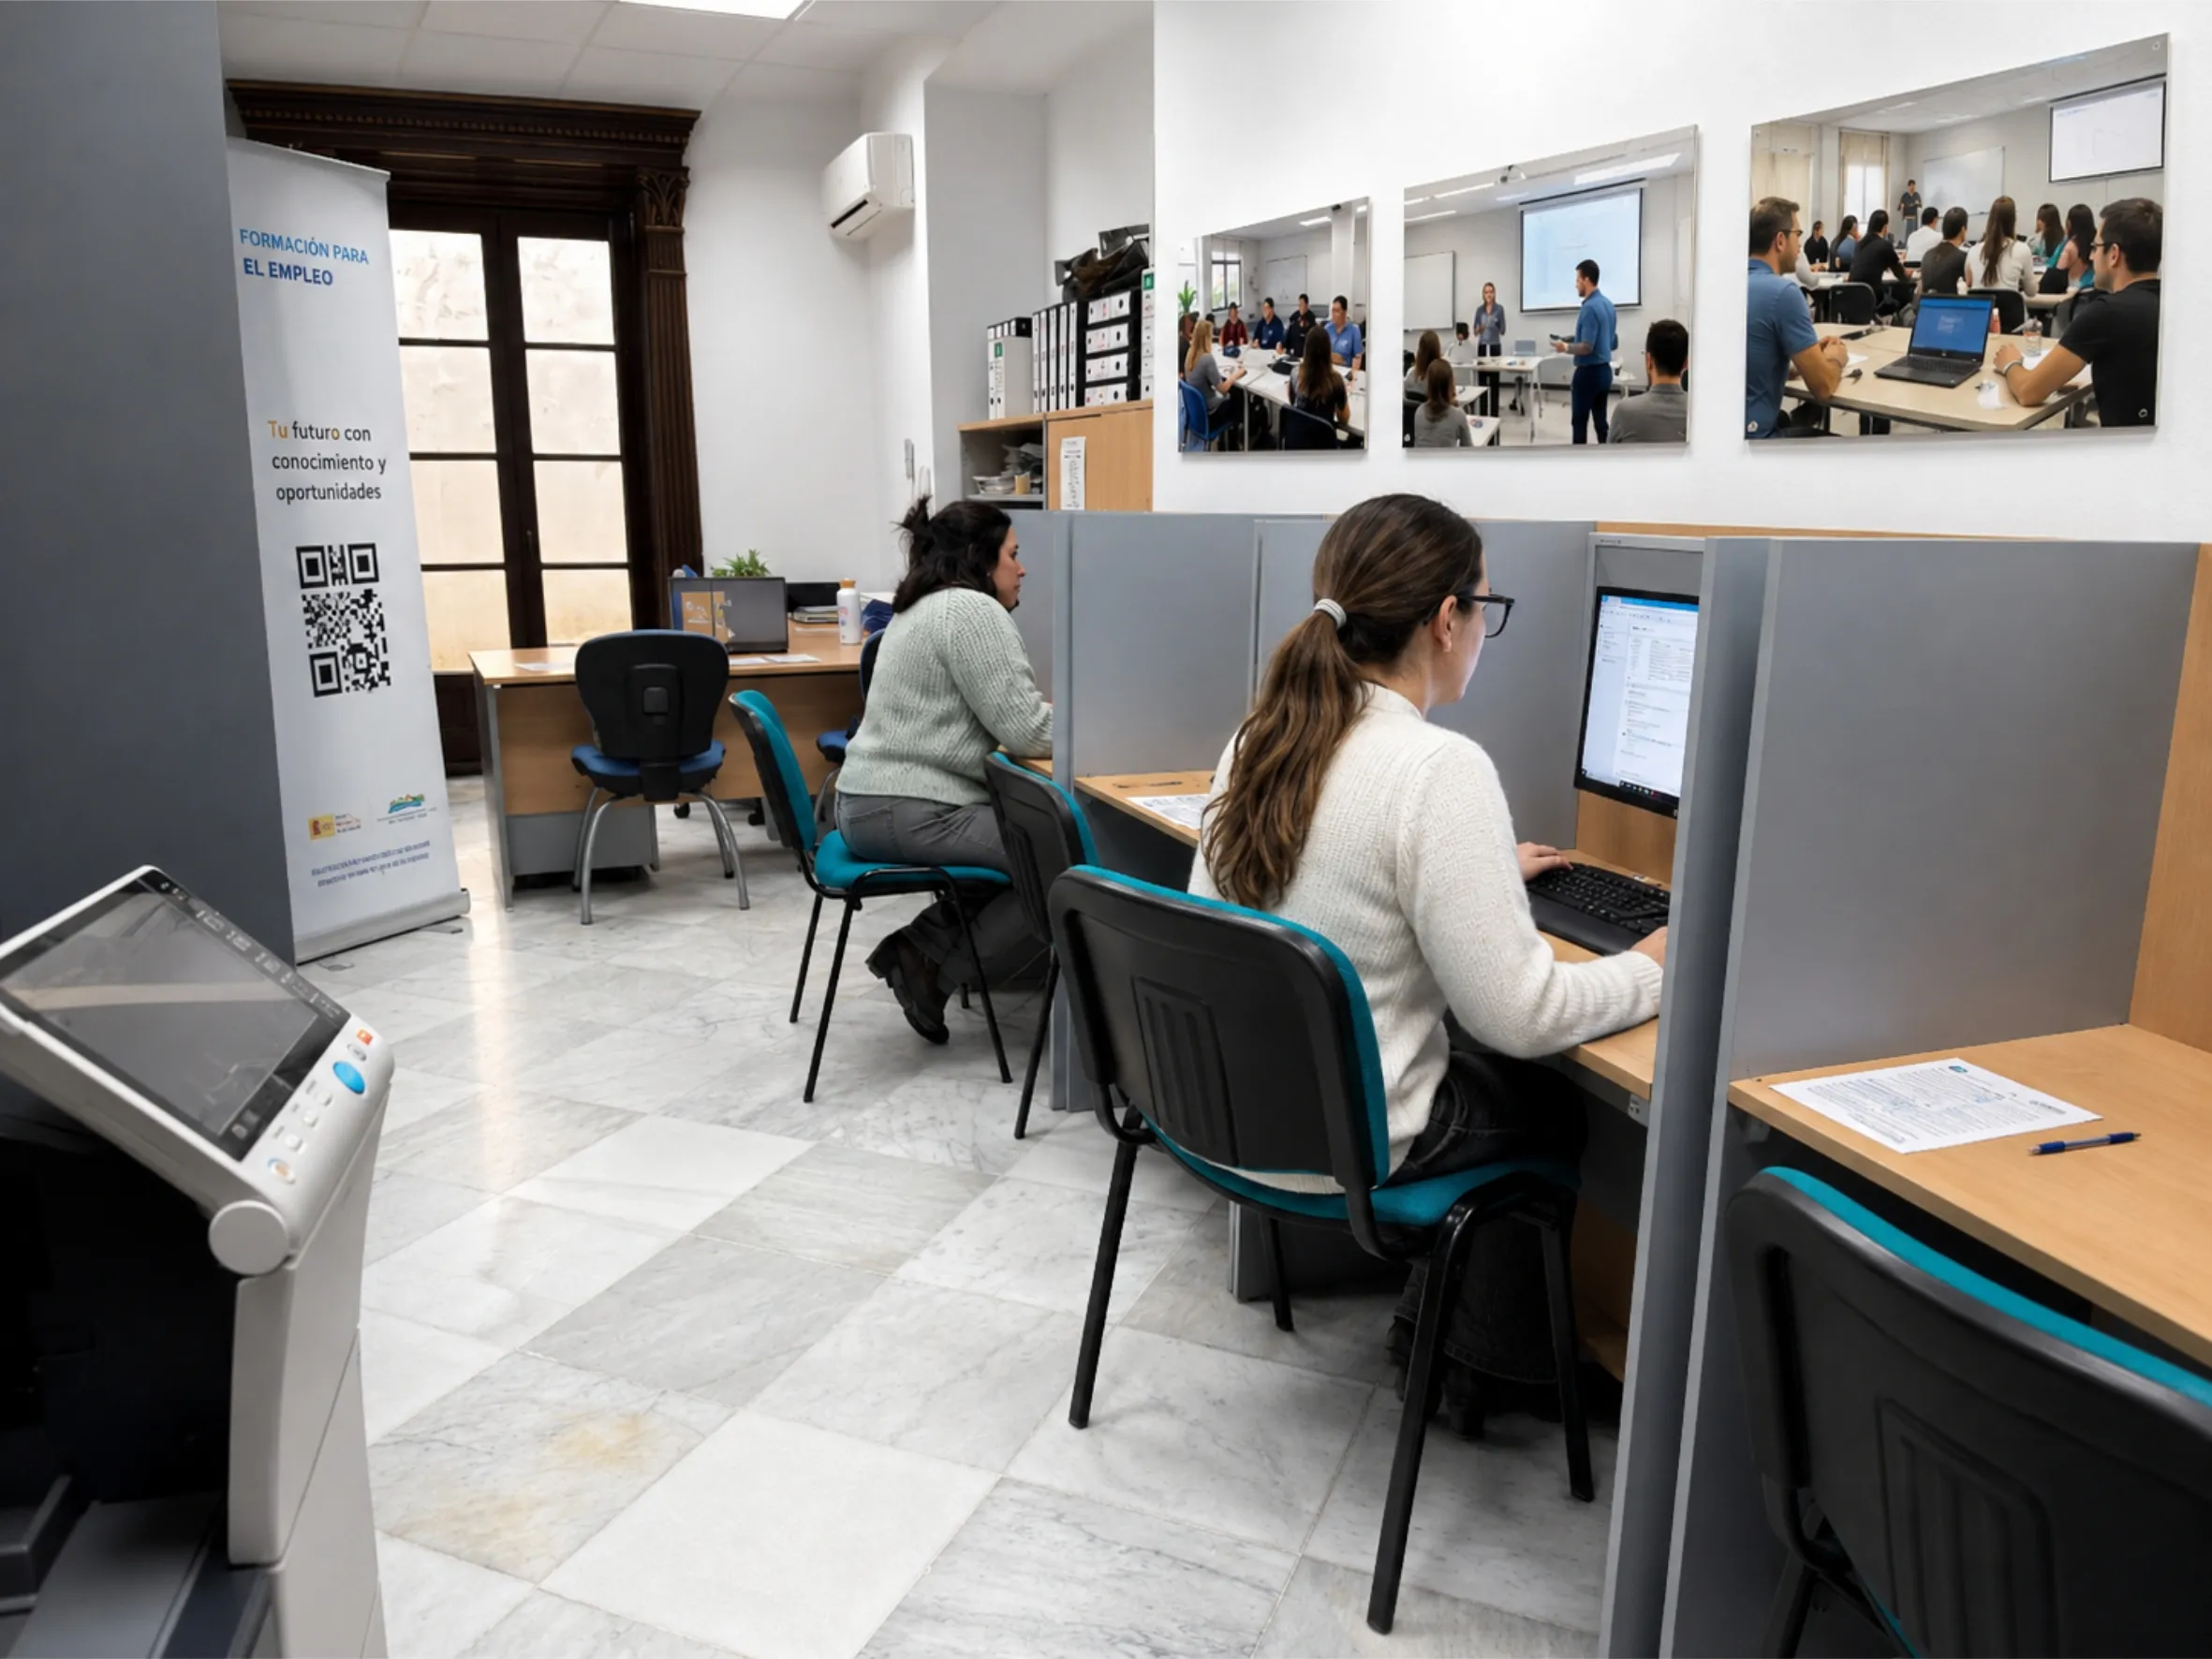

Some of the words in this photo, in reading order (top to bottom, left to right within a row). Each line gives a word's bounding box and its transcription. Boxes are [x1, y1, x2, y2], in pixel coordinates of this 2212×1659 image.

[239, 228, 329, 257] FORMACIÓN
[332, 244, 369, 264] PARA
[243, 257, 264, 276] EL
[269, 261, 333, 286] EMPLEO
[268, 420, 288, 438] Tu
[292, 421, 340, 440] futuro
[344, 428, 371, 442] con
[272, 453, 374, 470] conocimiento
[378, 458, 387, 475] y
[276, 482, 381, 505] oportunidades
